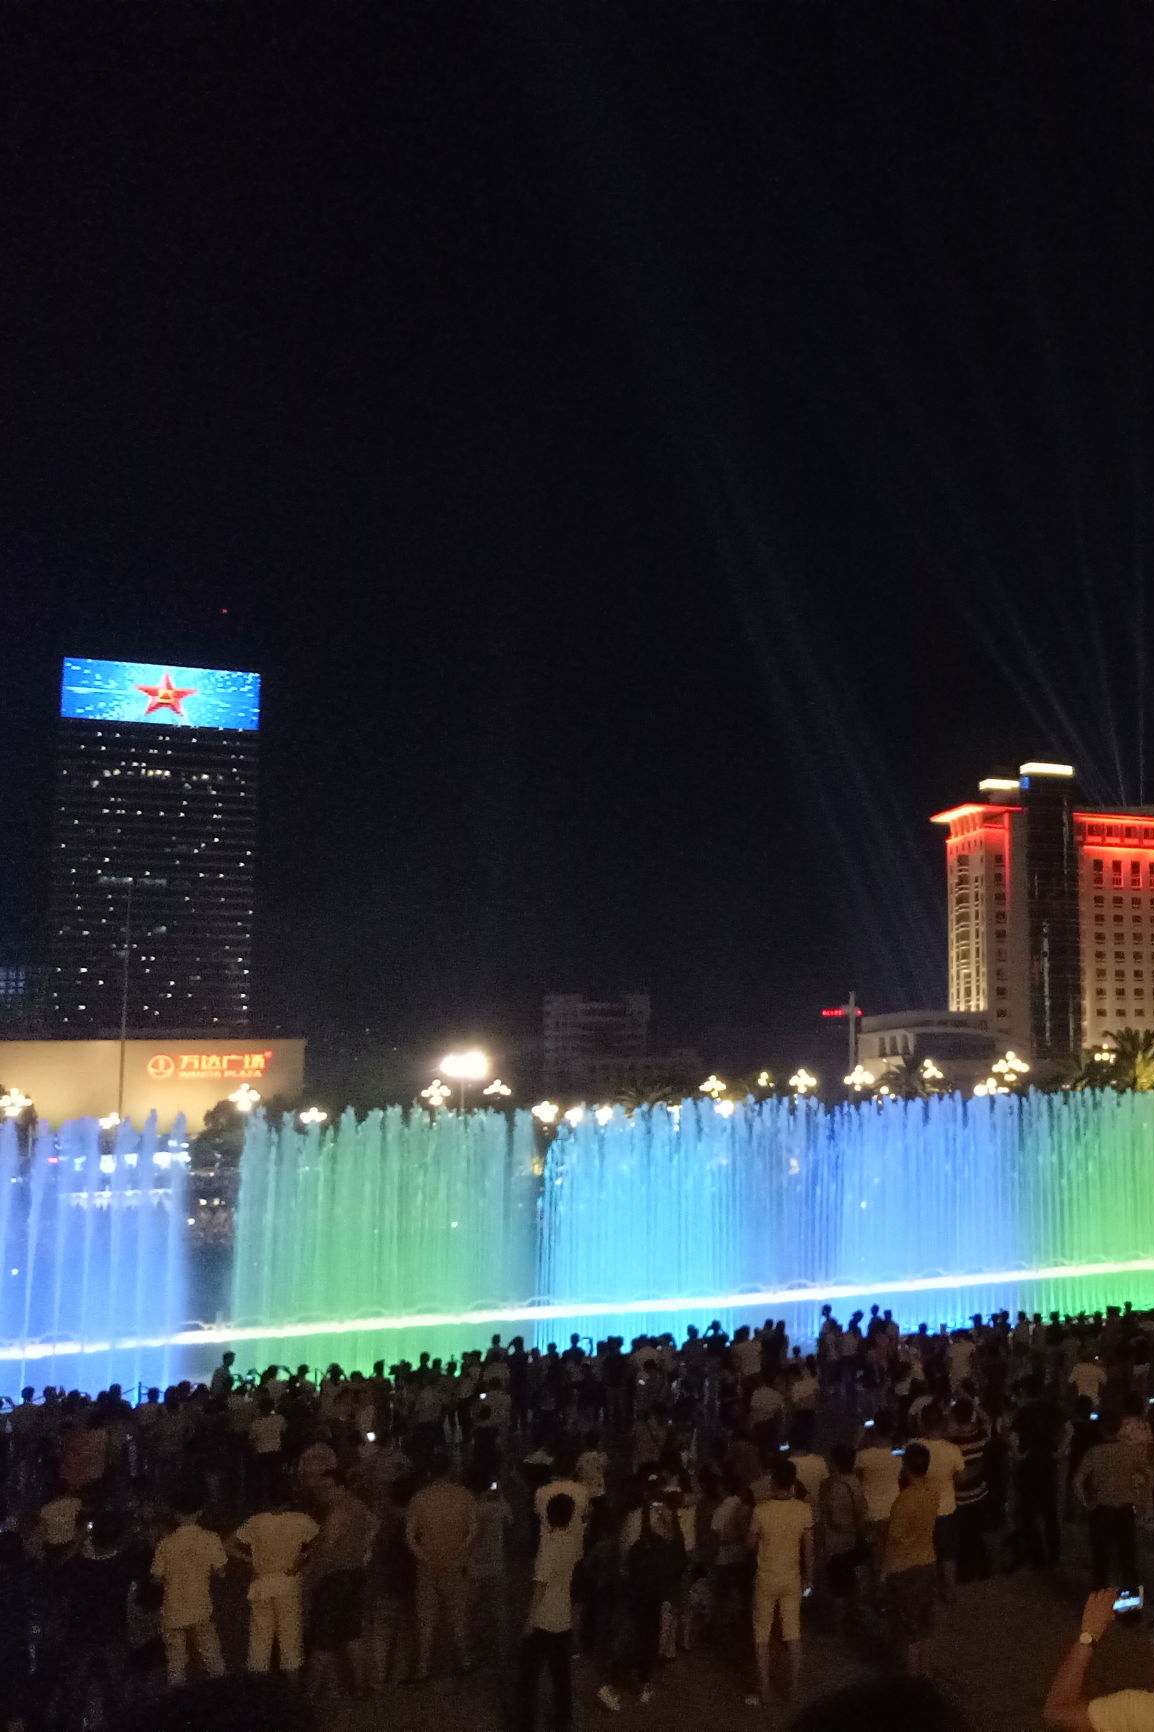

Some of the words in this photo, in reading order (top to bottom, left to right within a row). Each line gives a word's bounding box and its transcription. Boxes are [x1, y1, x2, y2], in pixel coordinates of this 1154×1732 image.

[179, 1053, 265, 1069] 万达广场
[224, 1070, 263, 1078] PLAZA
